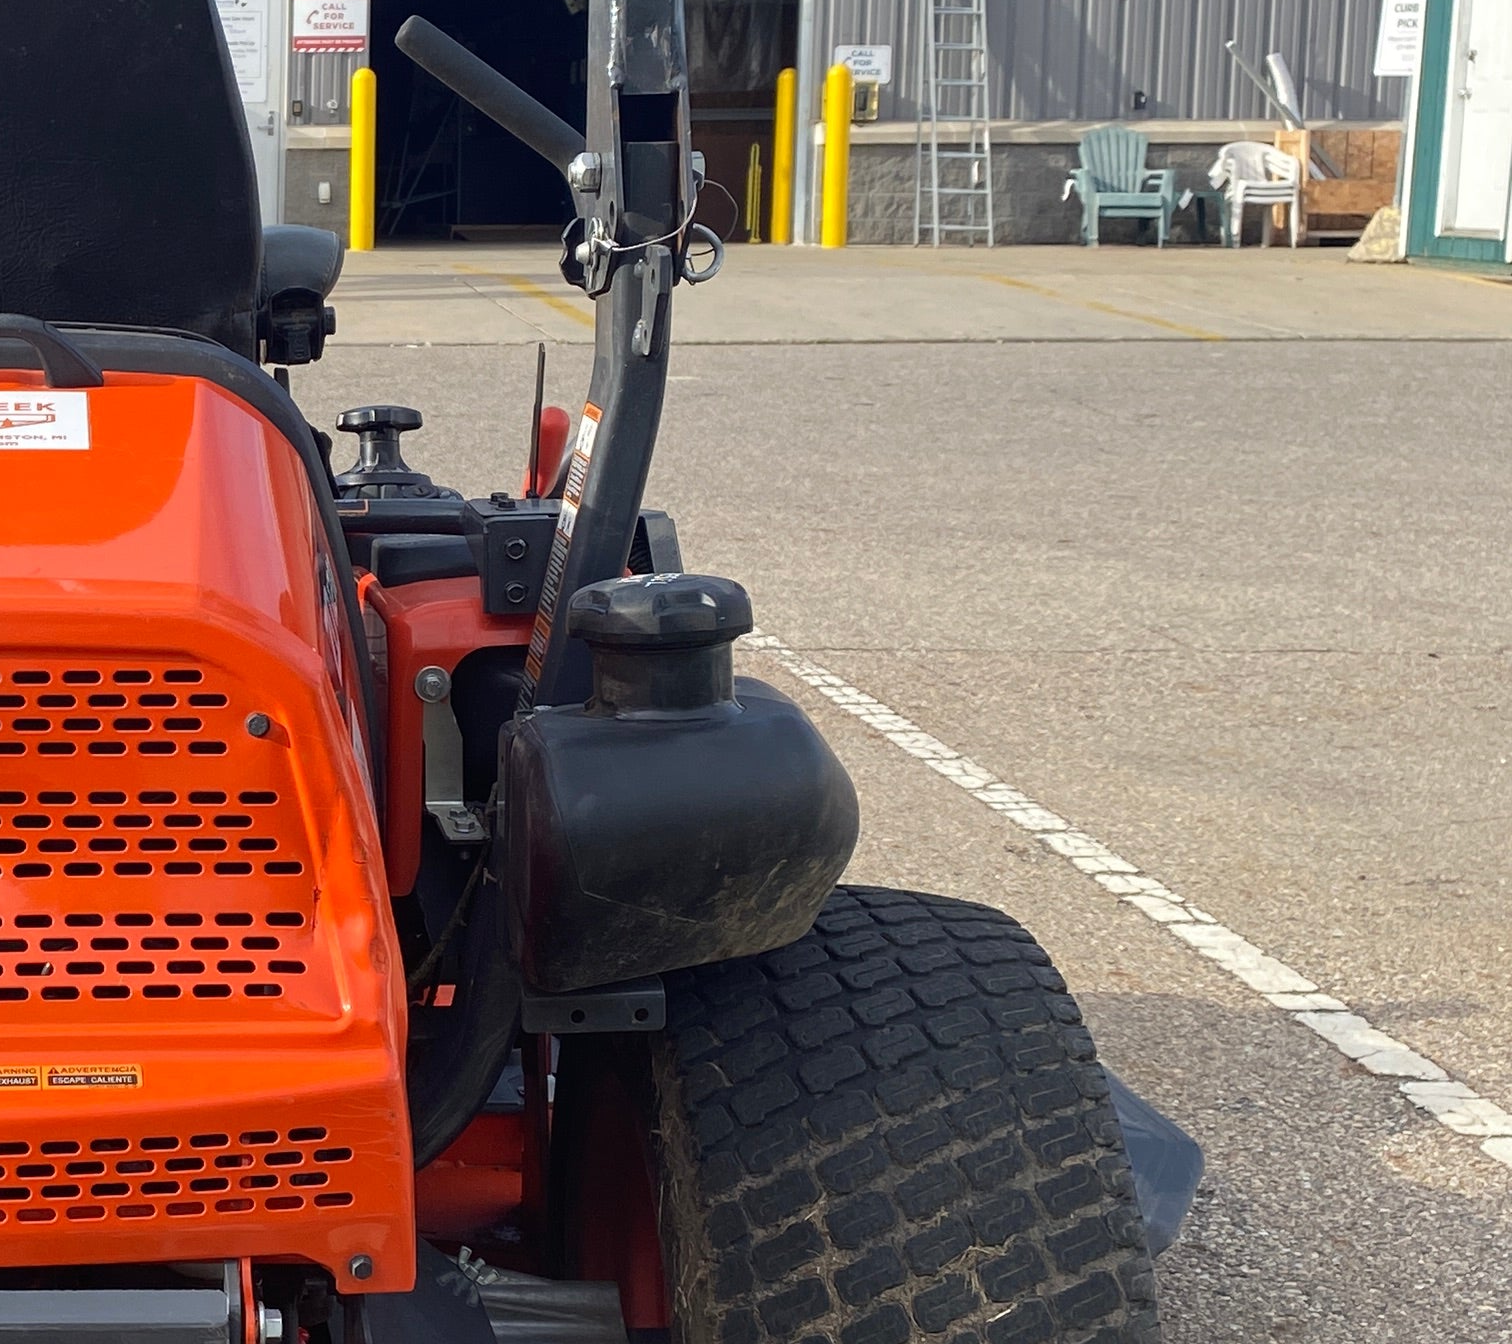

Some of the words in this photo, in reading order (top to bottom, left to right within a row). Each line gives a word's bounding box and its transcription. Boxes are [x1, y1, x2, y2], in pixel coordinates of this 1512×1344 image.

[1394, 3, 1420, 13] CURB
[313, 22, 355, 30] SERVICE
[1397, 18, 1418, 28] PICK
[60, 1066, 136, 1074] ADVERTENCIA
[90, 1076, 133, 1084] CALIENTE
